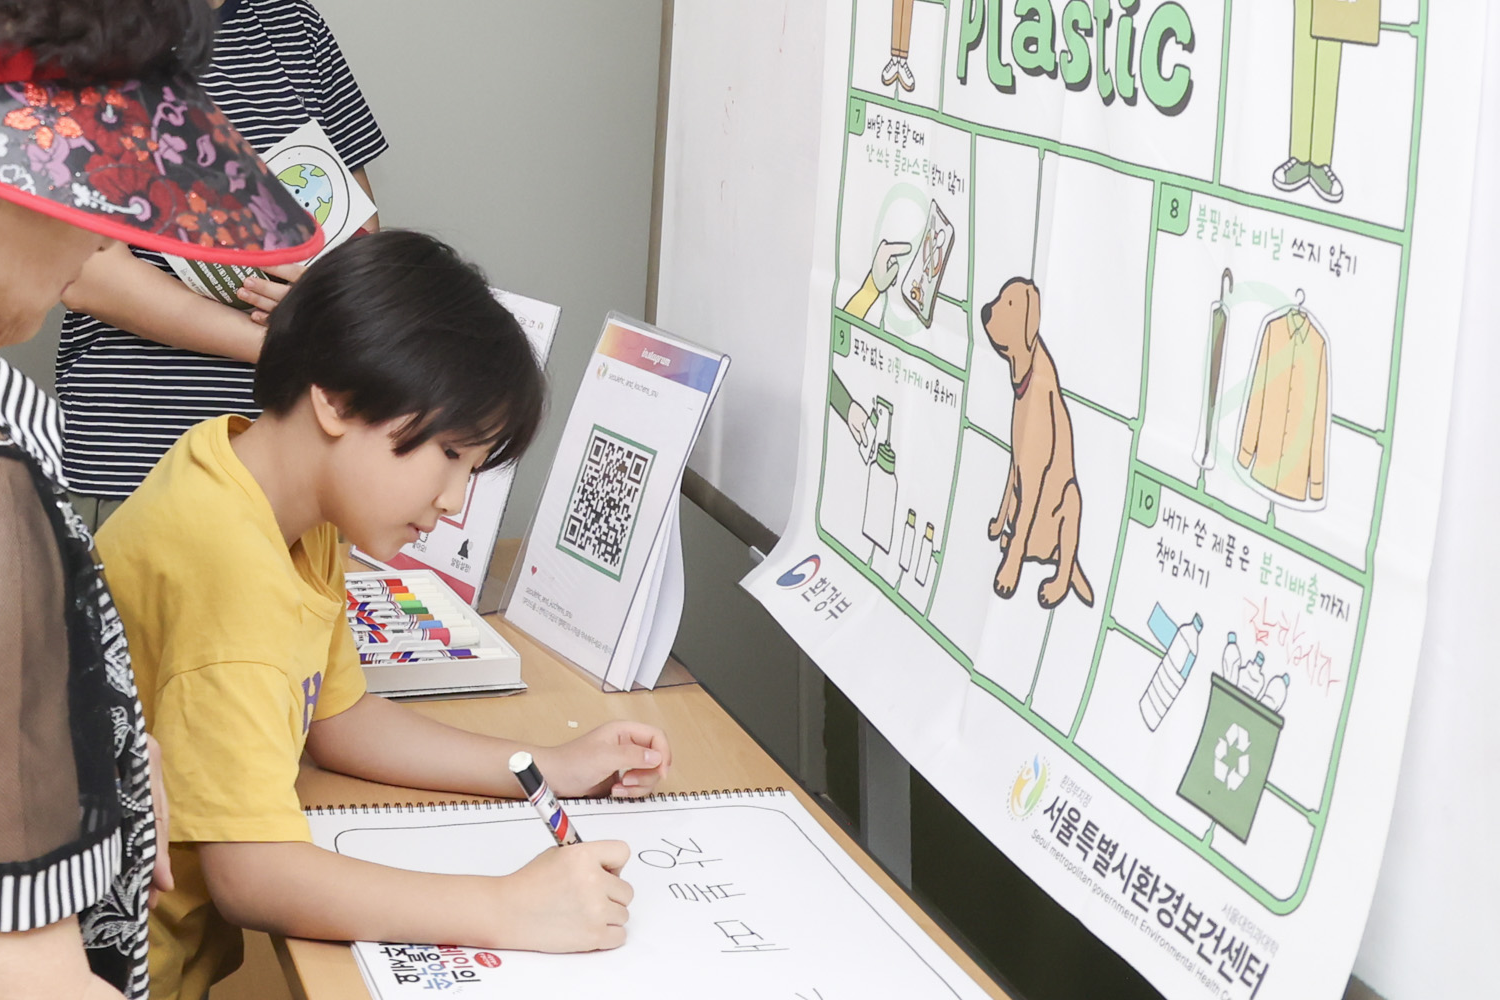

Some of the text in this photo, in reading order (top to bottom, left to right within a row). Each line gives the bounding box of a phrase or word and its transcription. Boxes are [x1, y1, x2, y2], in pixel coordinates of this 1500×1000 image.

[855, 108, 861, 124] 7
[867, 114, 925, 149] 배달 주문할 때
[947, 169, 965, 195] 않기
[1170, 198, 1179, 219] 8
[1196, 203, 1357, 278] 불필요한 비닐 쓰지 않기
[839, 330, 845, 346] 9
[854, 338, 870, 362] 포장
[870, 346, 884, 371] 없는
[925, 379, 958, 409] 이용하기
[1138, 489, 1155, 511] 10
[1156, 536, 1210, 589] 책임지기
[1162, 507, 1190, 535] 내가
[1194, 518, 1208, 548] 쓴
[1259, 551, 1351, 622] 분리배출까지
[800, 576, 853, 622] 환경부
[1030, 828, 1222, 998] Seoul metropolitan government Environmental Health
[1042, 795, 1271, 1000] 서울특별시환경보건센터
